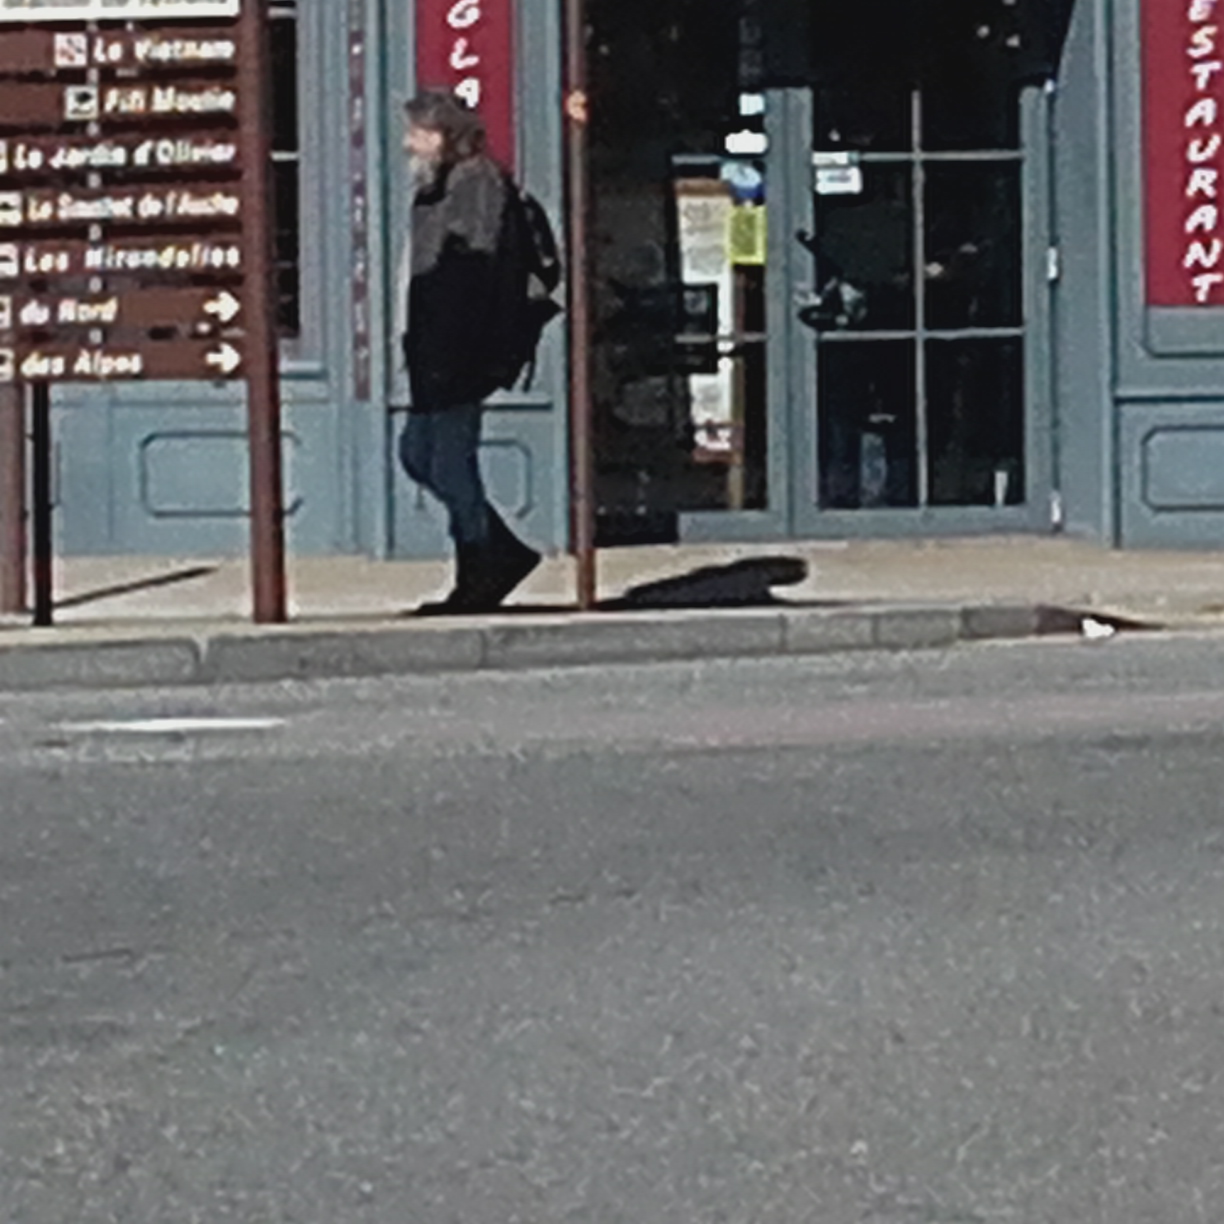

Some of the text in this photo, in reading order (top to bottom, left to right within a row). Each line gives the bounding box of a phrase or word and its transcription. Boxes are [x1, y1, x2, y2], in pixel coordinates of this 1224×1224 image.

[94, 39, 235, 63] Le Vietnam
[14, 144, 43, 170] Le
[29, 197, 53, 221] Le
[25, 247, 69, 273] Les
[58, 297, 118, 323] Nord
[21, 347, 142, 378] des Alpes
